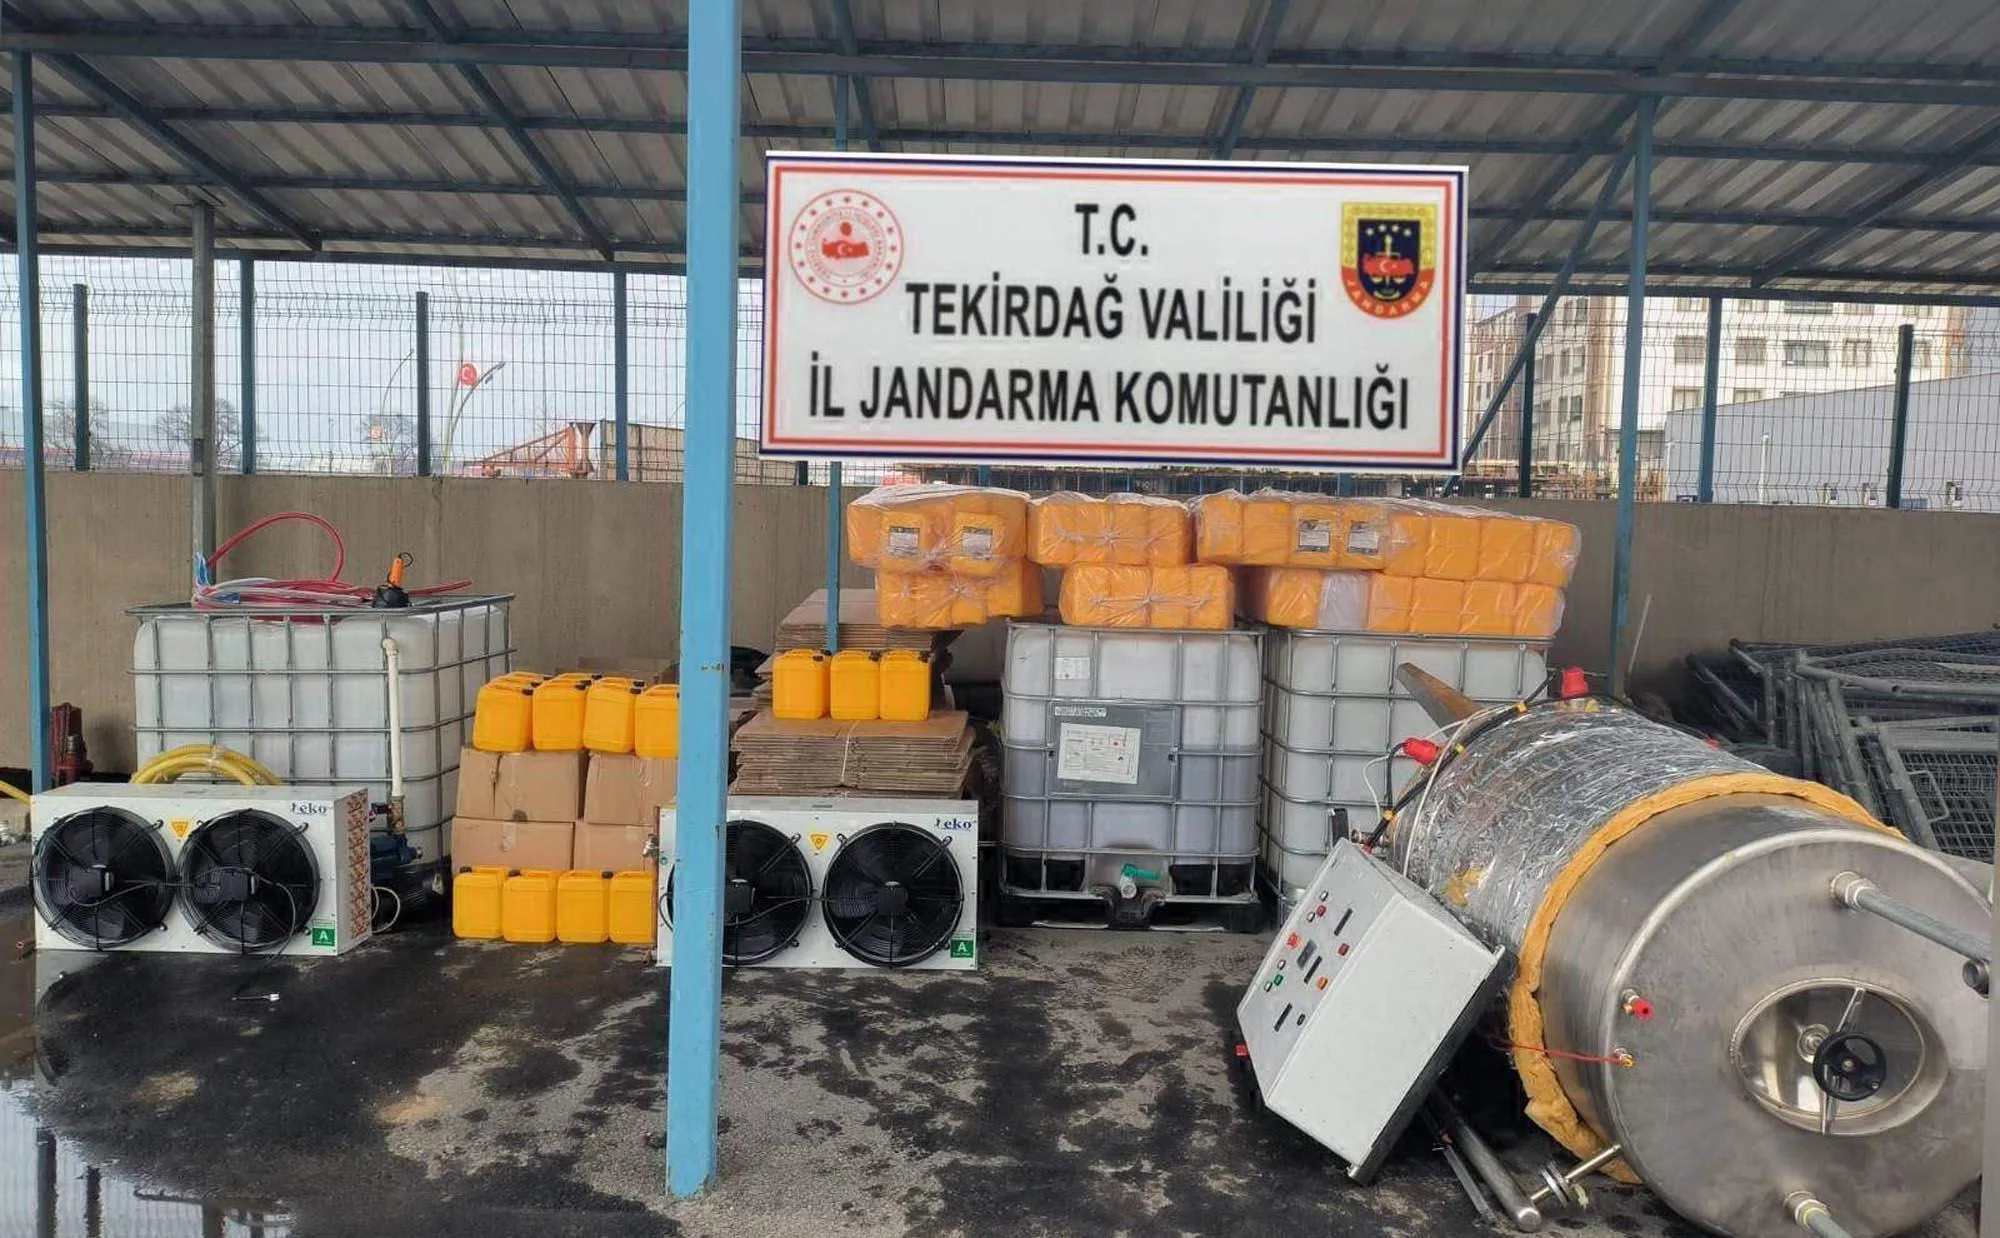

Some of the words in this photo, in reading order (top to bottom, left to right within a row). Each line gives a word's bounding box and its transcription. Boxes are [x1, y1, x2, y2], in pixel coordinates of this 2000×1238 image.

[1074, 203, 1149, 257] T.C.
[905, 271, 1123, 340] TEKİRDAĞ
[1139, 276, 1316, 344] VALİLİĞİ
[809, 351, 845, 418] İL
[859, 366, 1100, 423] JANDARMA
[1115, 363, 1408, 430] KOMUTANLIĞI
